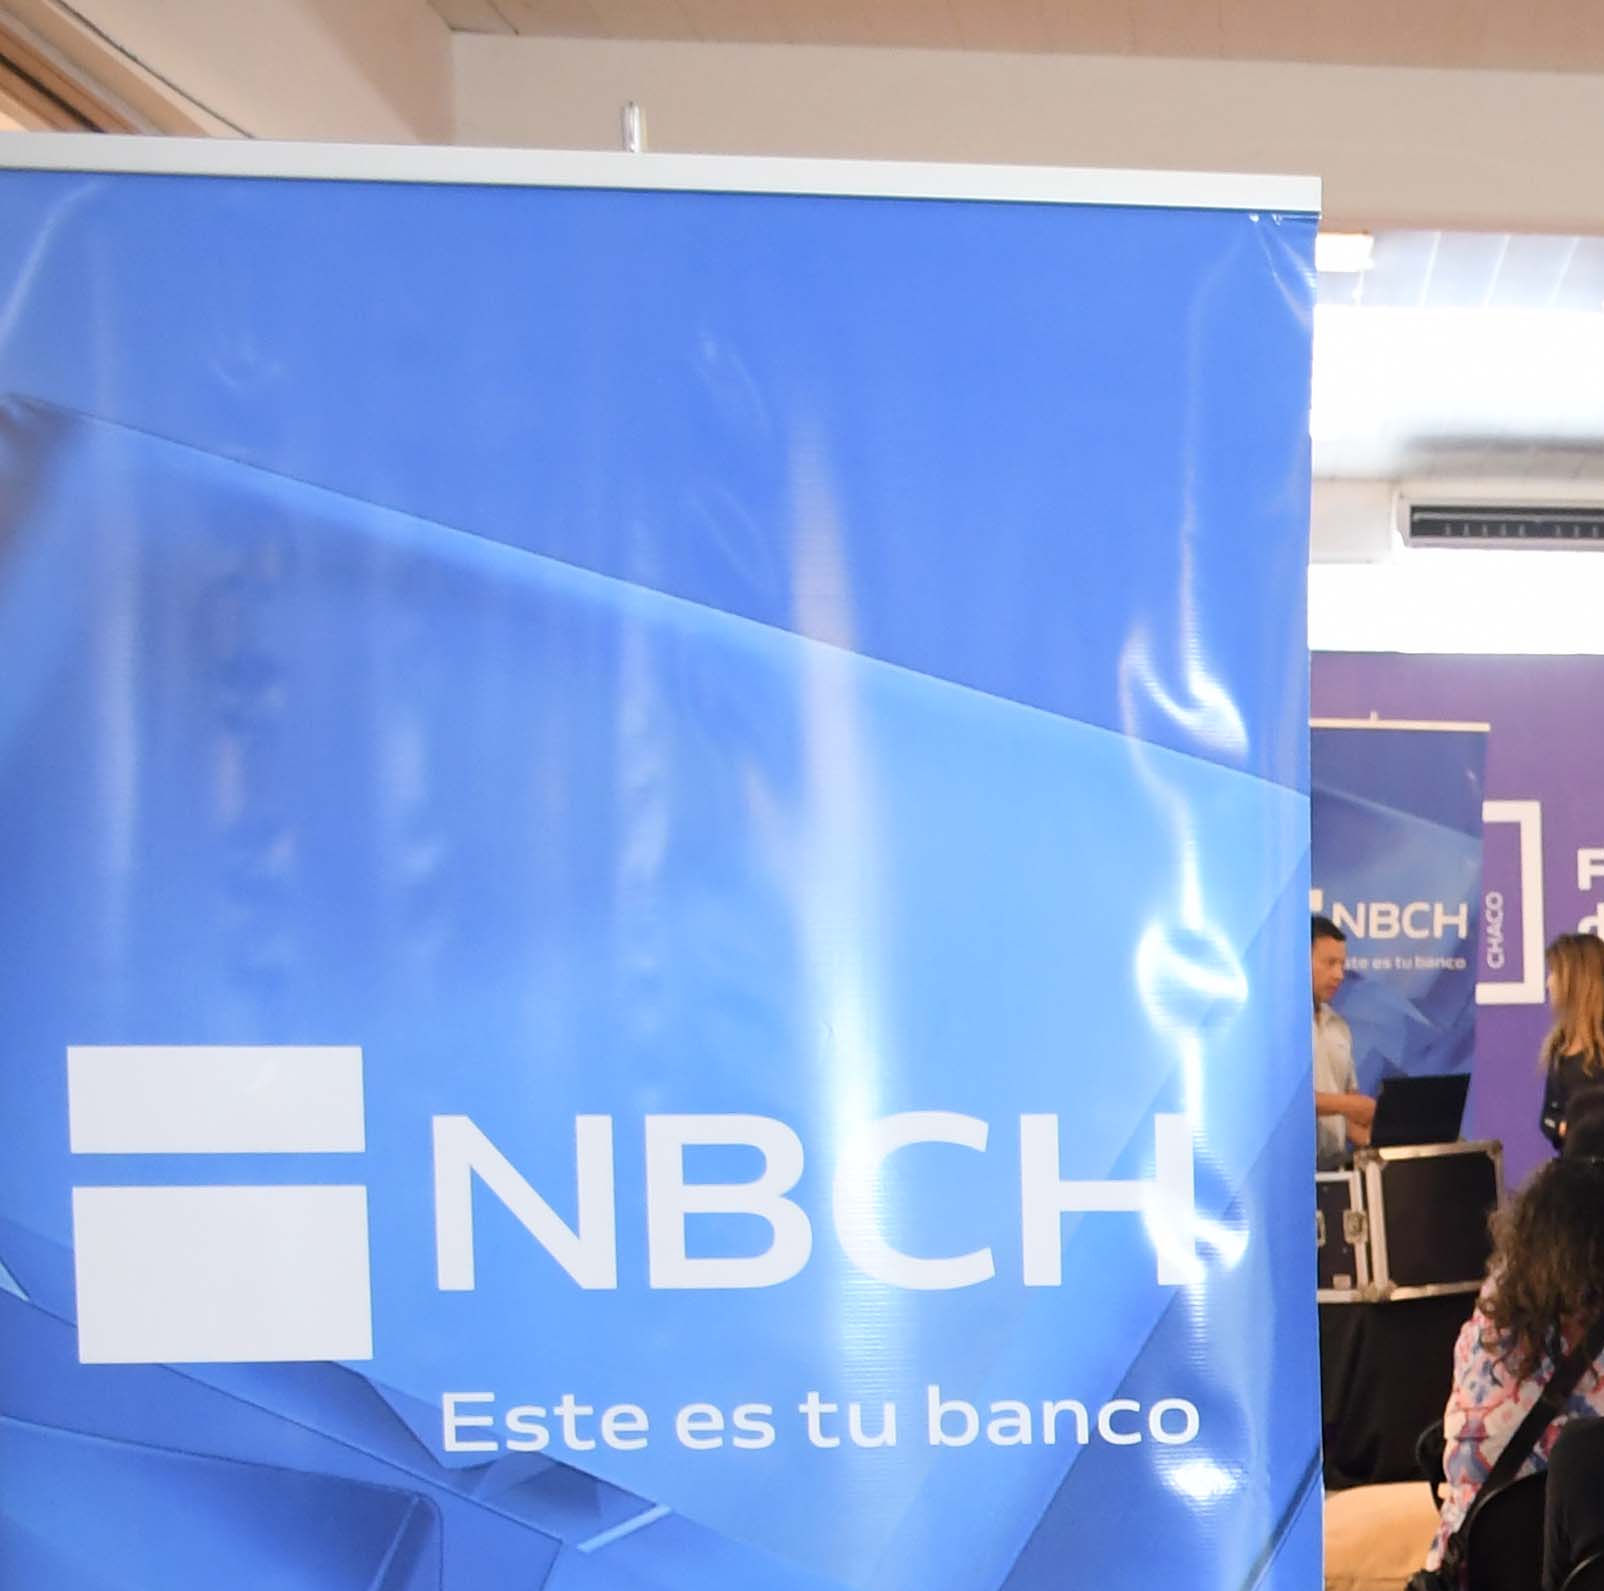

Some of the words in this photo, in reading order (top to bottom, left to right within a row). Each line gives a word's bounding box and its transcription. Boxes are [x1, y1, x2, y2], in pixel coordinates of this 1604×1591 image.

[1332, 901, 1469, 940] NBCH
[1485, 891, 1504, 969] CHACO
[1343, 956, 1369, 970] ste
[1372, 957, 1391, 970] es
[1395, 956, 1411, 969] tu
[1414, 955, 1467, 970] banco
[431, 1110, 1198, 1293] NBCH
[440, 1391, 650, 1454] Este
[674, 1397, 777, 1449] es
[802, 1389, 898, 1449] tu
[926, 1384, 1201, 1449] banco
